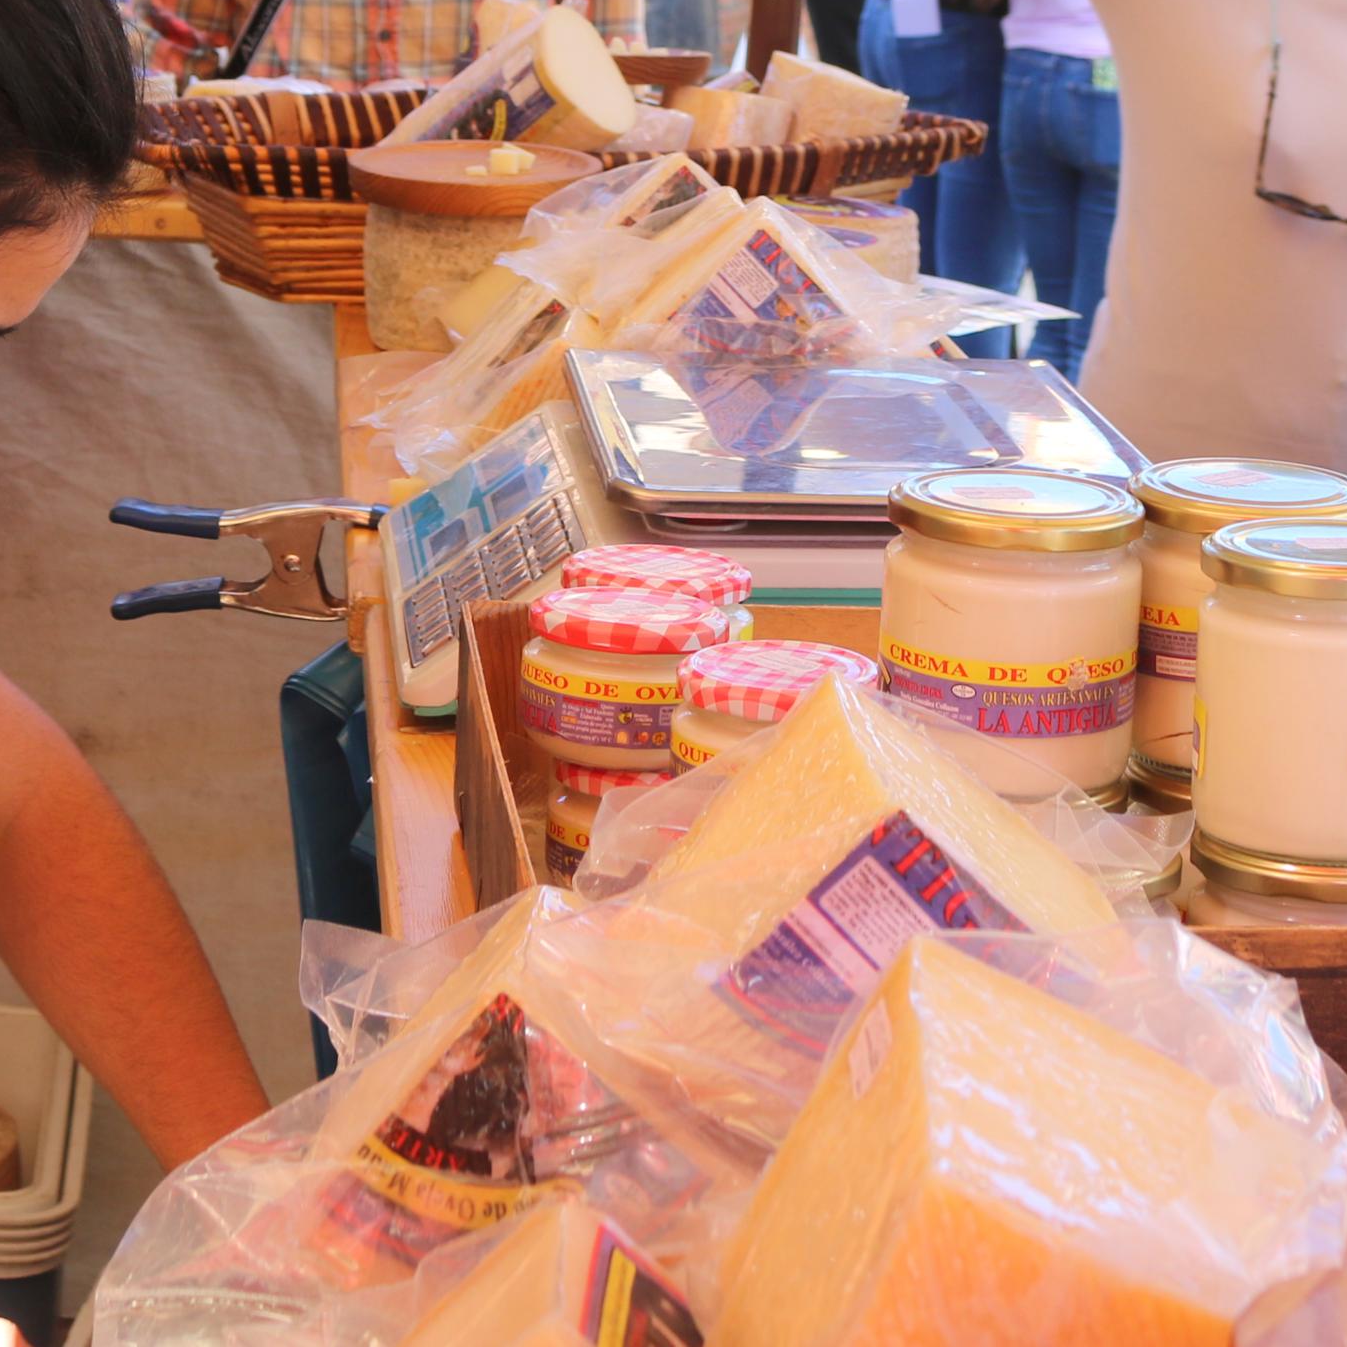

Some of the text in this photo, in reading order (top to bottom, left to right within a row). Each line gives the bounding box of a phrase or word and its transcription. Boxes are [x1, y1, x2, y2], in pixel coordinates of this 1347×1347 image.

[890, 644, 969, 678] CREMA
[988, 666, 1028, 683] DE
[1047, 658, 1124, 685] QESO
[584, 681, 619, 699] DE
[982, 690, 1035, 708] QUESOS
[1039, 687, 1115, 707] ARTESANALES
[976, 703, 1117, 735] LA ANTIGUA
